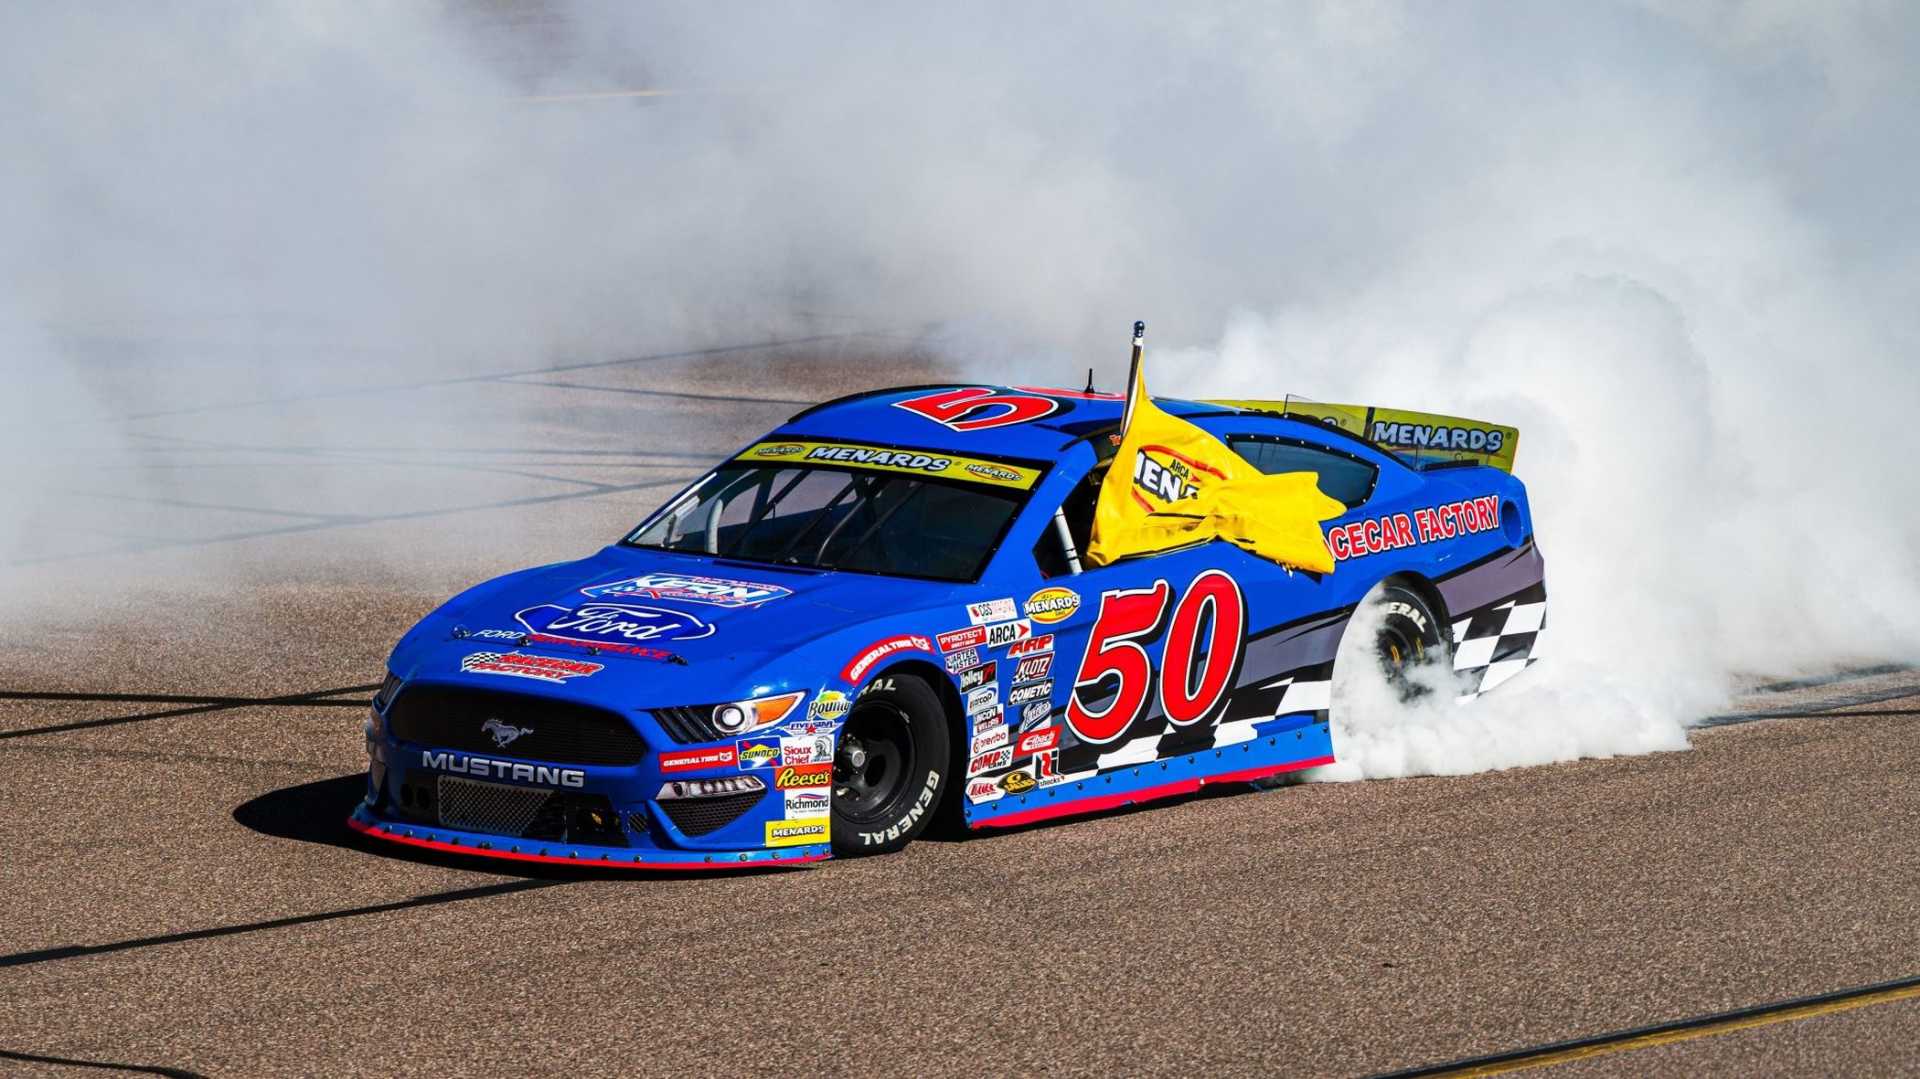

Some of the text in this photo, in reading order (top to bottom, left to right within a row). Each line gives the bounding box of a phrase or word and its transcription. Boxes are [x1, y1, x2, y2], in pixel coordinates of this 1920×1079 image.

[1374, 421, 1503, 452] MENARDS
[809, 446, 951, 471] MENARDS
[967, 463, 1023, 481] MENARDS
[1169, 459, 1190, 481] ARCA
[1414, 495, 1500, 544] FACTORY
[1024, 595, 1081, 616] MENARDS
[547, 605, 681, 640] Ford
[473, 629, 527, 641] FORD
[940, 627, 983, 644] PYROTECT
[989, 624, 1016, 646] ARCA
[1009, 636, 1051, 656] ARP
[1018, 657, 1051, 677] KLOTZ
[1064, 569, 1245, 745] 50
[1009, 681, 1052, 703] COMETIC
[663, 754, 718, 767] GENERAL TIRE
[740, 749, 780, 761] SUNOCO
[784, 745, 812, 756] Sioux
[784, 754, 810, 765] Chief
[422, 751, 585, 788] MUSTANG
[970, 751, 1002, 773] COMP
[776, 767, 830, 787] Reese's
[785, 795, 829, 810] Richmond
[858, 770, 941, 846] GENERAL
[772, 825, 825, 838] MENARDS
